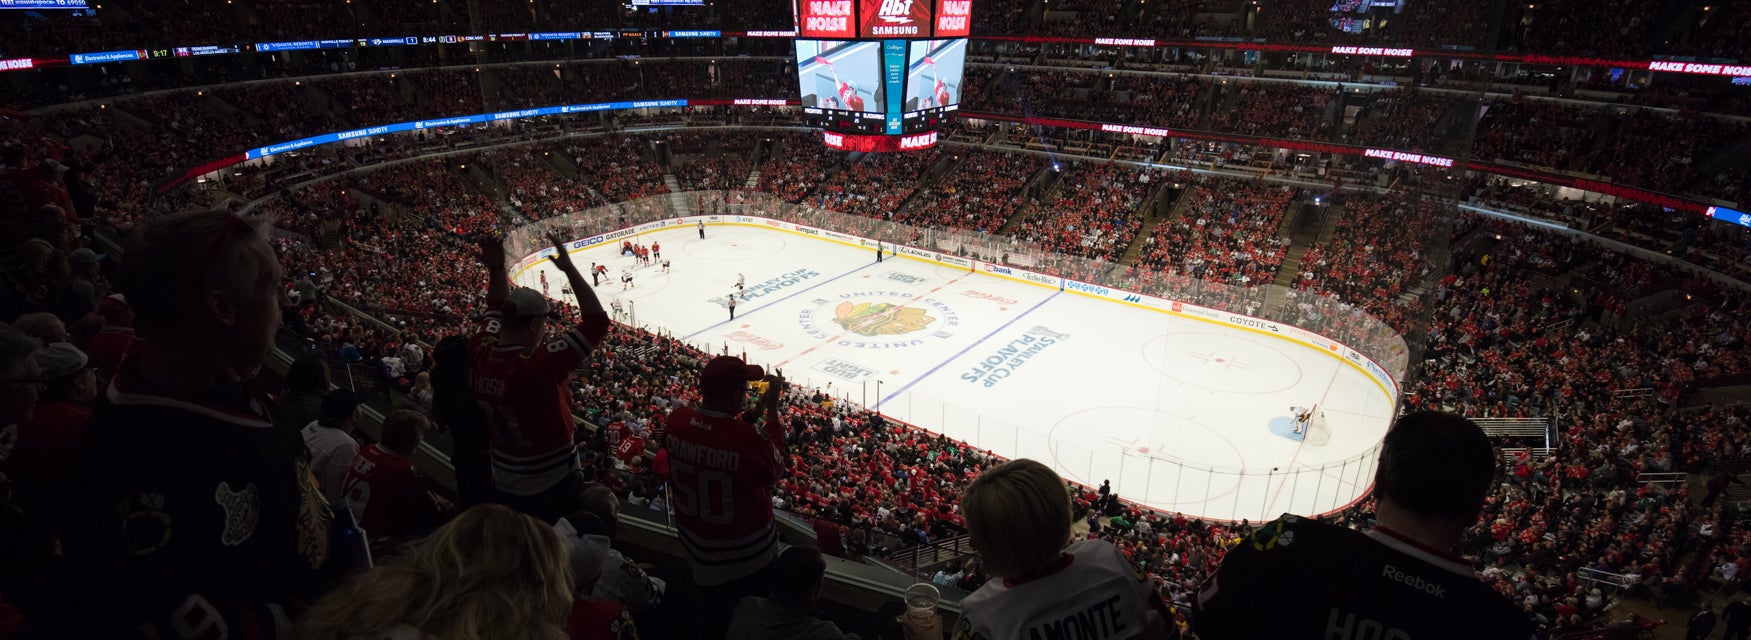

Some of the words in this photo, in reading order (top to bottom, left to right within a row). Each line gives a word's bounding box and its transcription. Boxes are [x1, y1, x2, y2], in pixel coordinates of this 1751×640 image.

[810, 1, 850, 16] MAKE
[879, 0, 913, 16] Abt
[942, 1, 969, 16] MAKE
[806, 17, 848, 31] NOISE
[938, 16, 966, 30] NOISE
[872, 26, 918, 35] SAMSUNG
[110, 52, 134, 60] Appliances
[7, 58, 32, 69] NOISE
[1649, 62, 1684, 72] MAKE
[1685, 64, 1722, 74] SOME
[494, 111, 520, 119] SAMSUNG
[338, 130, 366, 139] SAMSUNG
[368, 126, 387, 135] SUHDTV
[1102, 124, 1122, 132] MAKE
[1123, 126, 1144, 134] SOME
[1144, 127, 1168, 136] NOISE
[270, 144, 290, 153] Electronics
[294, 140, 313, 148] Appliances
[901, 134, 929, 148] MAKE
[1365, 149, 1393, 159] MAKE
[1394, 151, 1421, 162] SOME
[1422, 155, 1453, 167] NOISE
[606, 228, 635, 240] GATORADE
[825, 232, 854, 240] WeatherTech
[574, 236, 604, 248] GEICO
[907, 250, 931, 258] LEXUS
[782, 268, 807, 279] CUP
[994, 266, 1012, 275] bank
[740, 270, 820, 301] PLAYOFFS
[925, 298, 958, 326] CENTER
[800, 309, 826, 340] CENTER
[1230, 316, 1266, 329] COYOTE
[838, 340, 923, 348] UNITED
[960, 334, 1036, 382] PLAYOFFS
[1006, 336, 1055, 370] STANLEY
[824, 360, 873, 376] LIGHT
[824, 366, 858, 379] BUD
[983, 368, 1010, 388] CUP
[618, 440, 632, 453] 19
[667, 434, 740, 471] CRAWFORD
[669, 458, 735, 526] 50
[1382, 564, 1448, 600] Reebok
[1030, 595, 1126, 640] AMONTE
